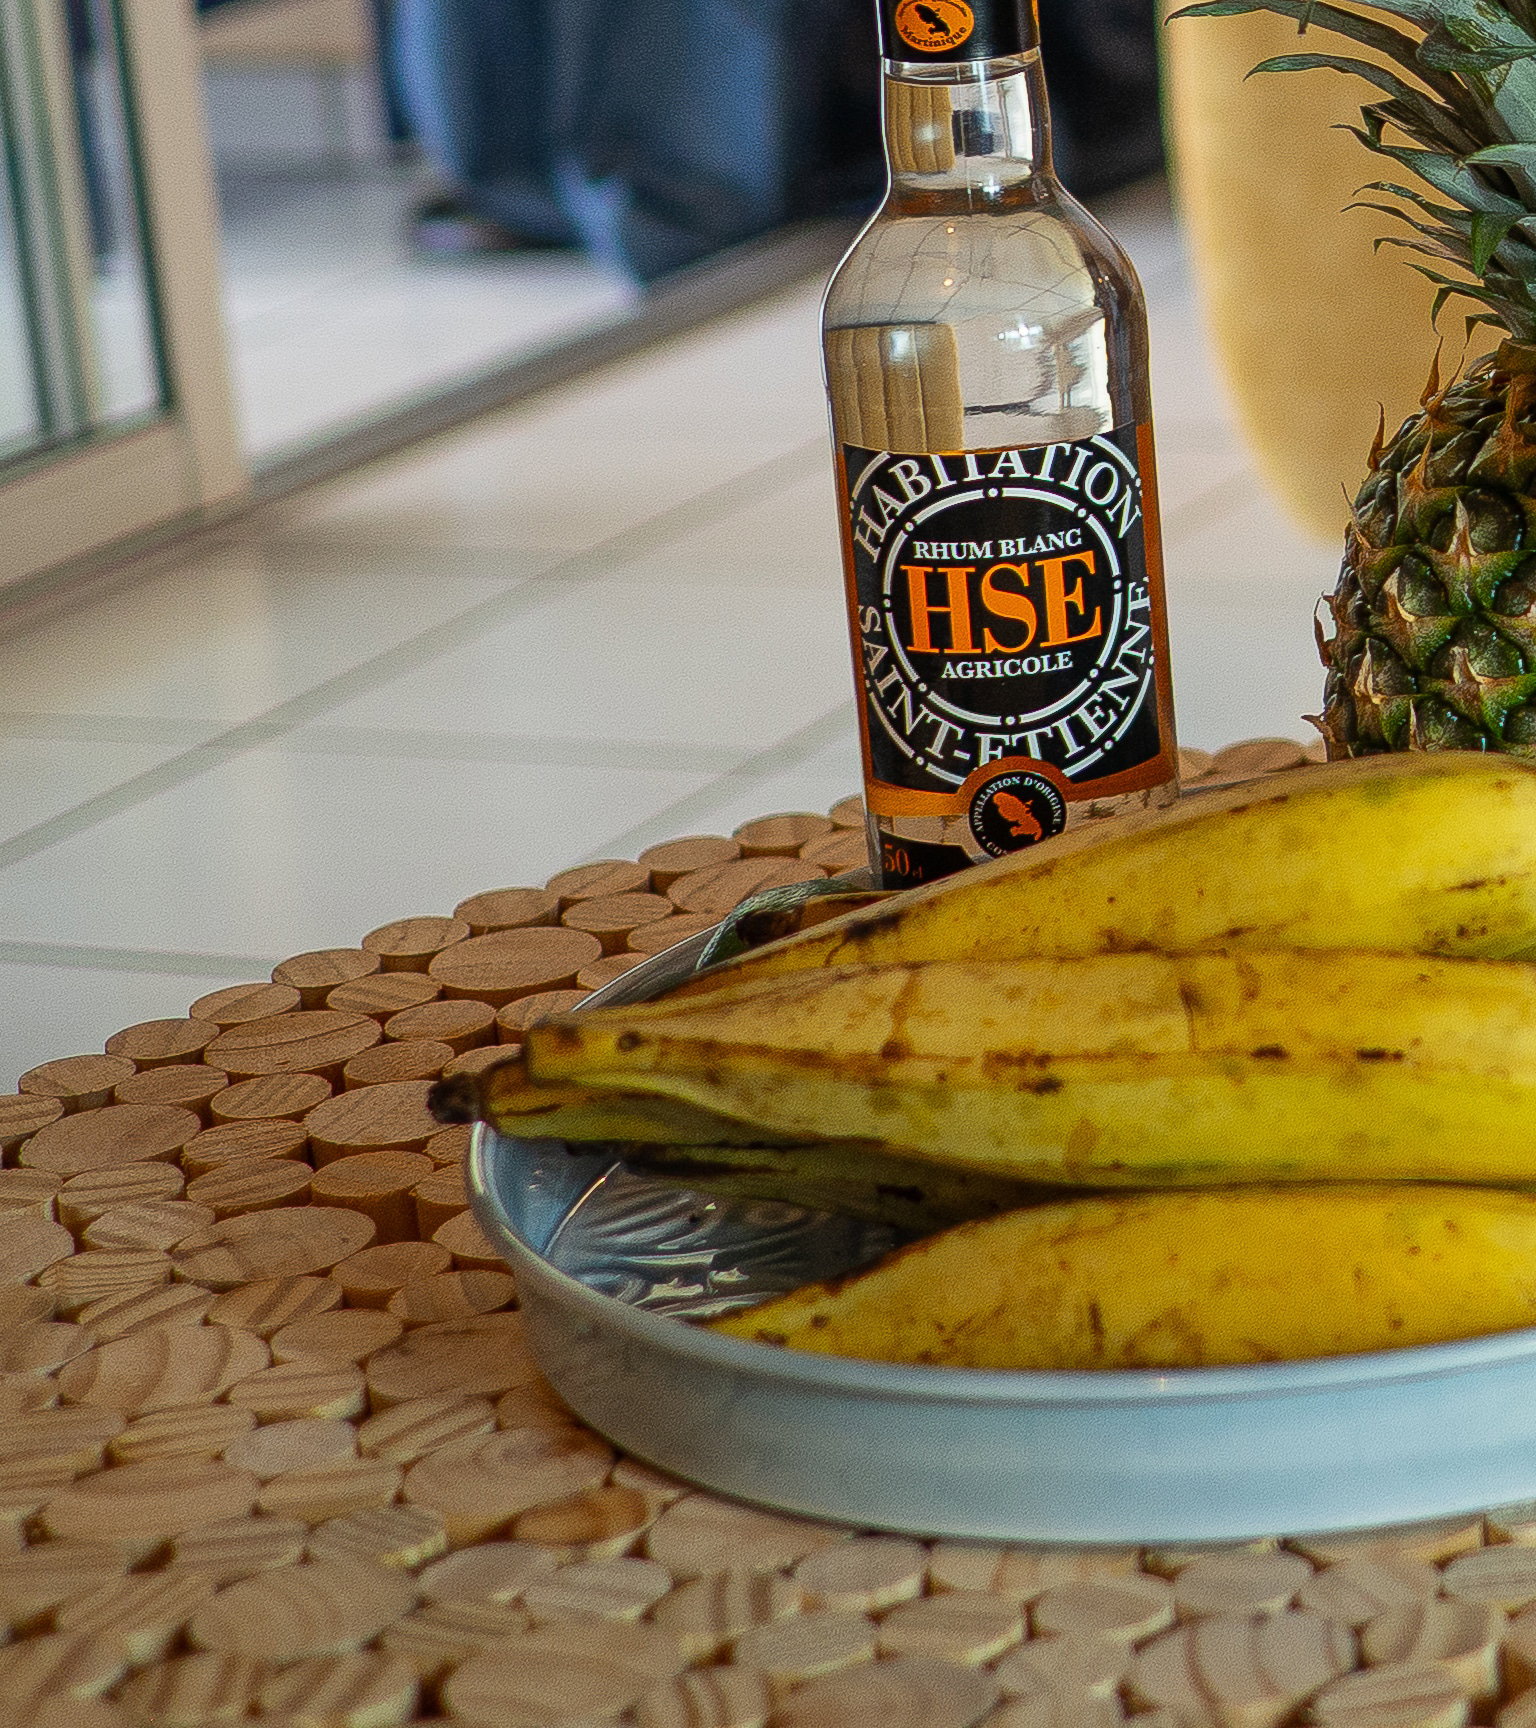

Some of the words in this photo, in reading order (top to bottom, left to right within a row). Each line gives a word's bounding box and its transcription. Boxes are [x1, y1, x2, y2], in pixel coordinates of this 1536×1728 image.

[900, 24, 967, 48] Martinique
[854, 442, 1142, 564] HABITATION
[913, 540, 994, 560] RHUM
[998, 528, 1083, 558] BLANC
[900, 550, 1102, 654] HSE
[858, 576, 1150, 770] SAINT-ETIENNE
[941, 650, 1074, 679] AGRICOLE
[973, 776, 1020, 832] APPELLATION
[883, 843, 910, 877] 50
